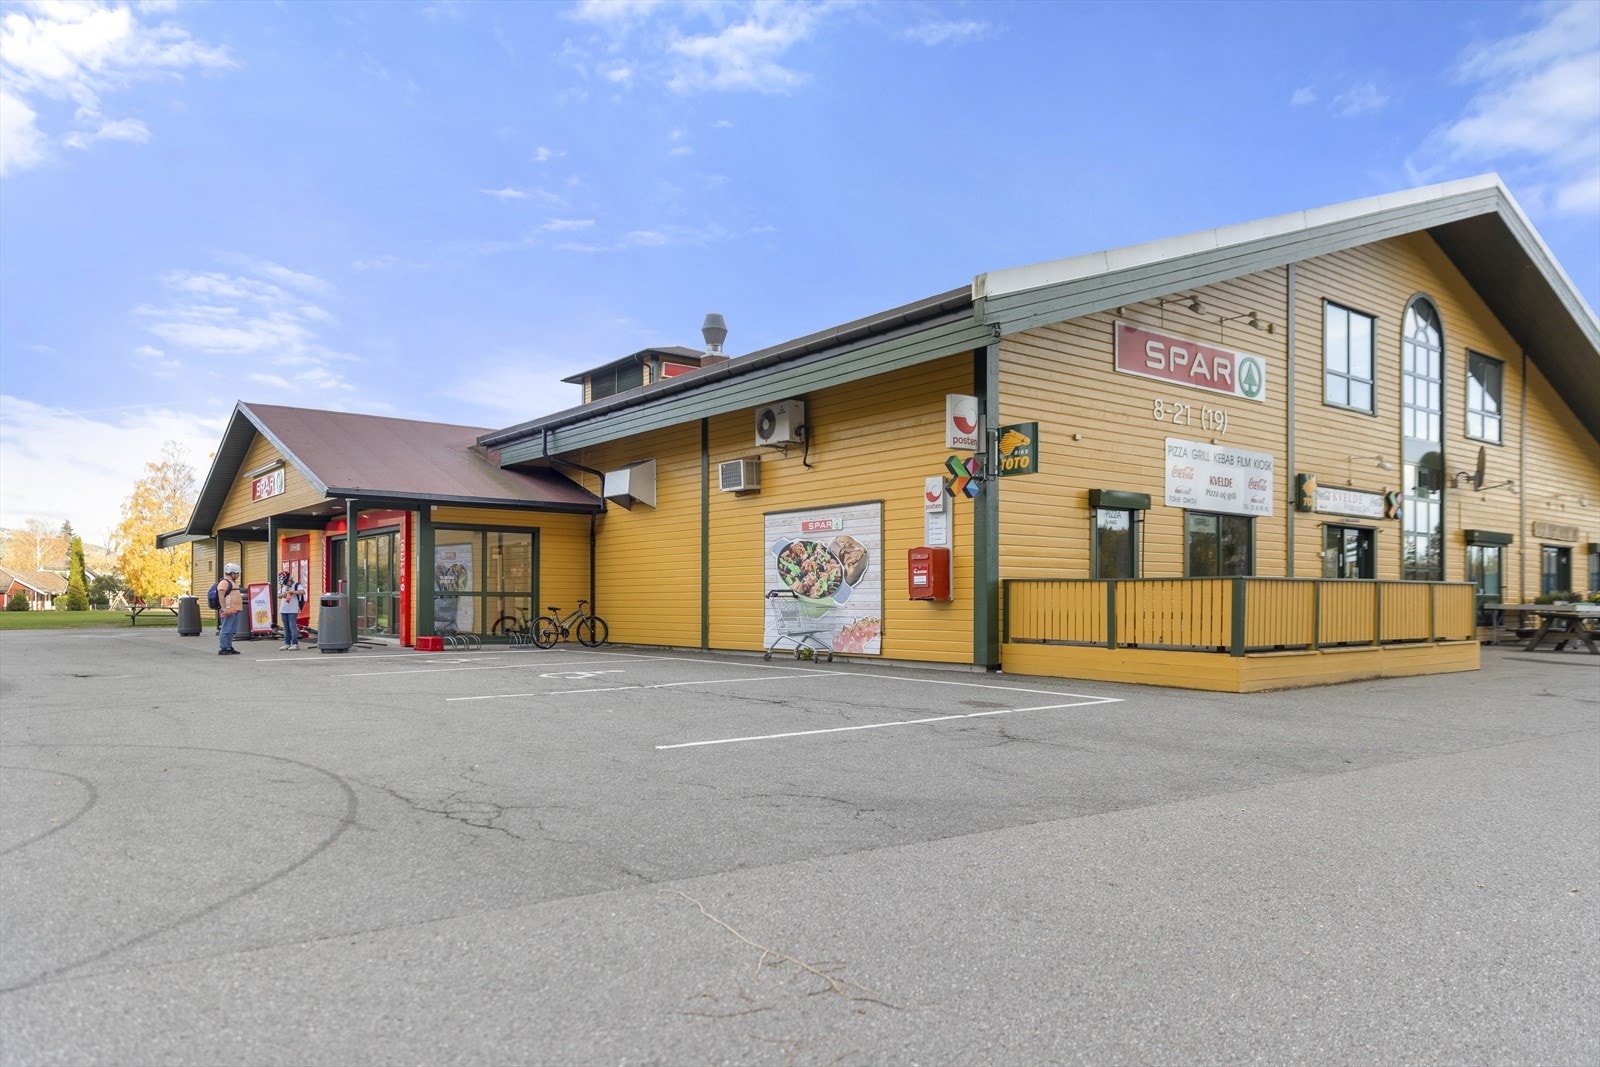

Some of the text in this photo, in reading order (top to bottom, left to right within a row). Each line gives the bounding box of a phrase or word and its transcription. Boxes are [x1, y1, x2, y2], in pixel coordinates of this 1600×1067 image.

[1145, 340, 1231, 385] SPAR
[1153, 398, 1228, 435] 8-21 (19)
[953, 436, 977, 446] posten
[1001, 456, 1030, 471] TOTO
[1168, 445, 1272, 471] PIZZA GRILL KEBAB FILM KIOSK
[256, 476, 276, 496] SPAR
[1209, 475, 1233, 488] KVELDE
[808, 520, 832, 530] SPAR
